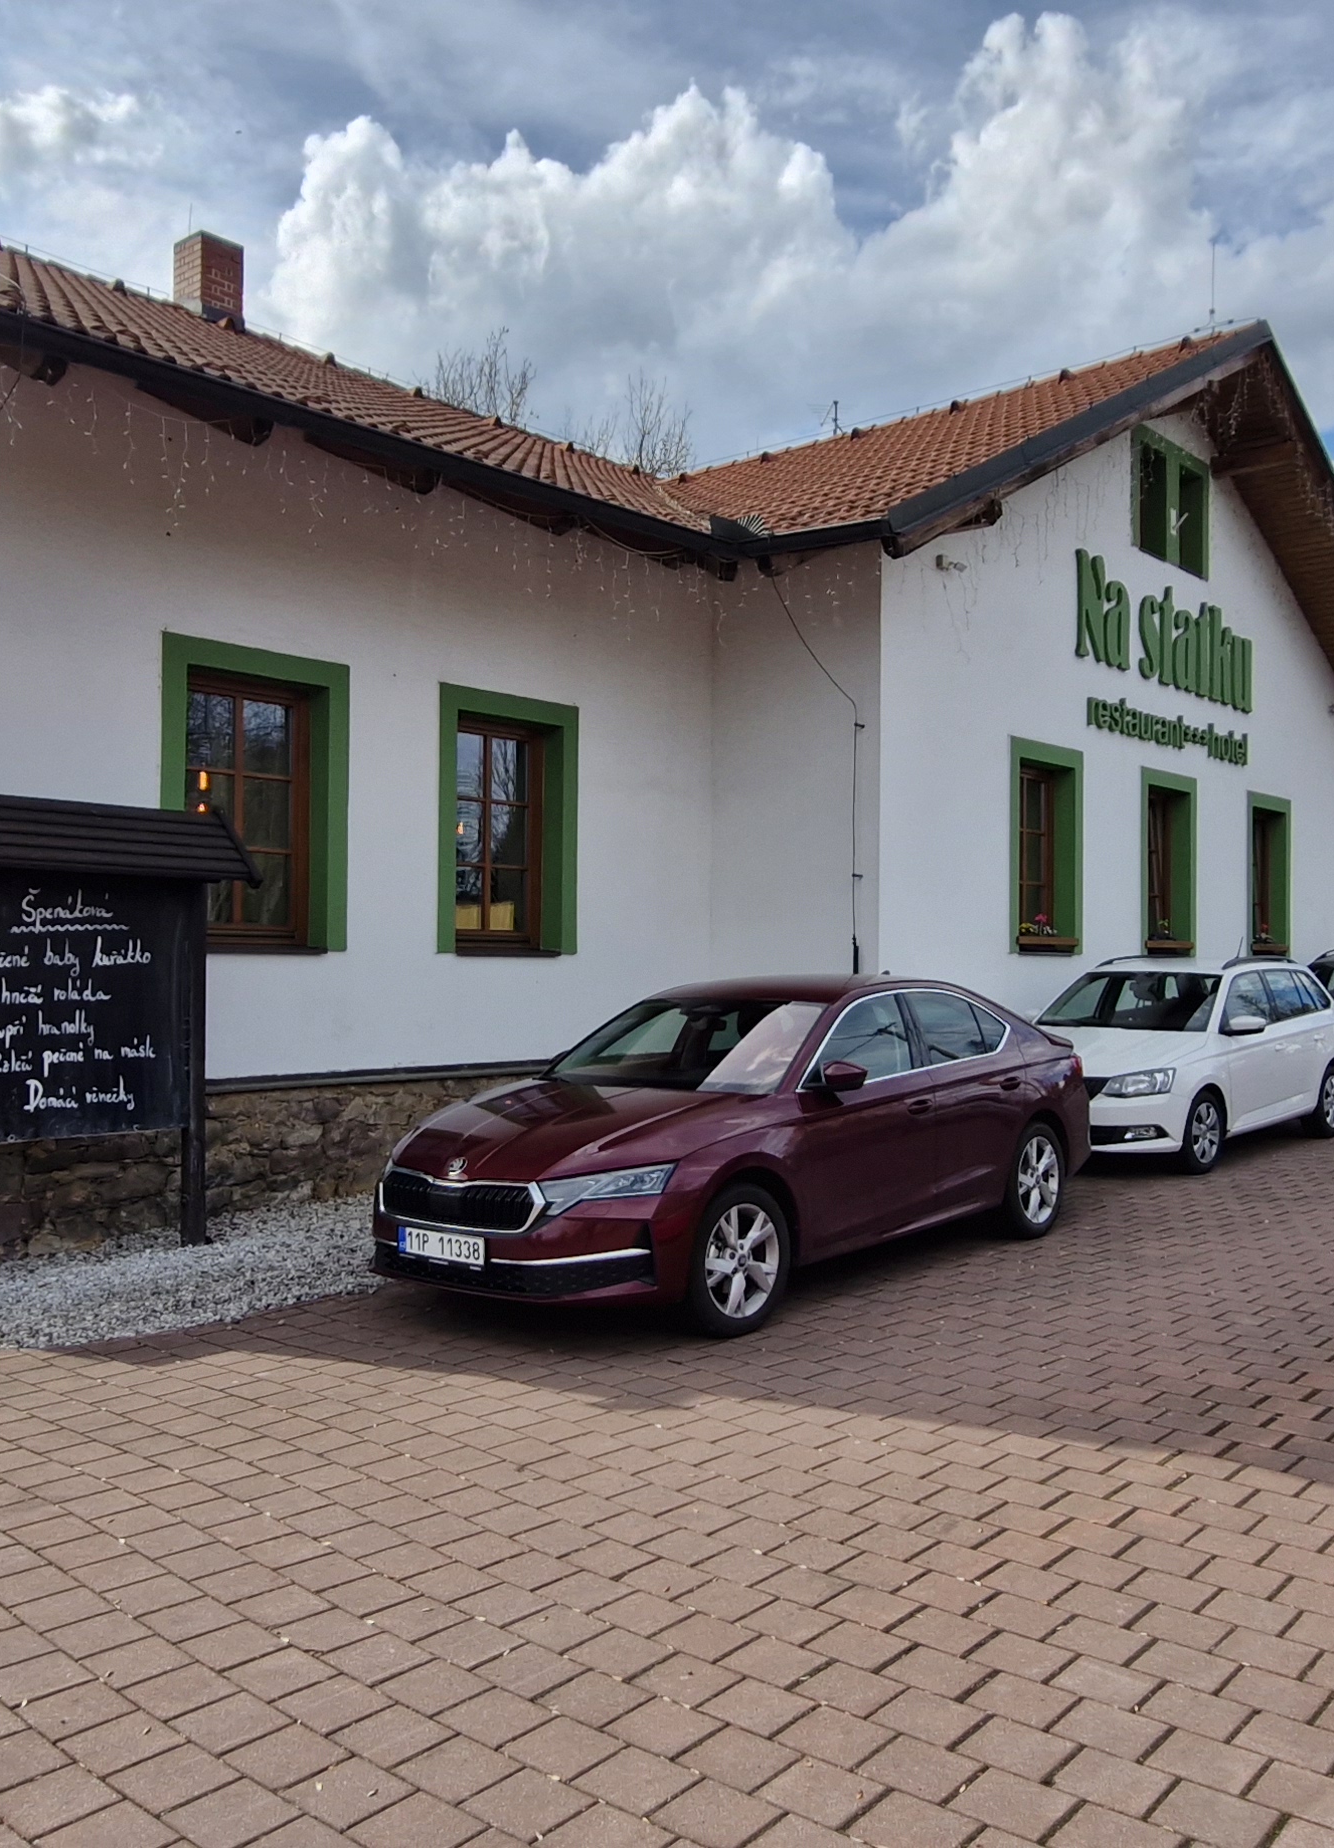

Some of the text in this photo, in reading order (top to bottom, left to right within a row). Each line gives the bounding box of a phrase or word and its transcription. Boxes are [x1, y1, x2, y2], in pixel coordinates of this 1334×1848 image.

[1075, 548, 1252, 713] Na statku
[44, 938, 80, 977] baby
[54, 978, 112, 1001] roláda
[38, 1009, 95, 1046] hranolky
[94, 1047, 114, 1060] na
[24, 1079, 78, 1113] Domácí
[407, 1230, 480, 1261] 11P 11338
